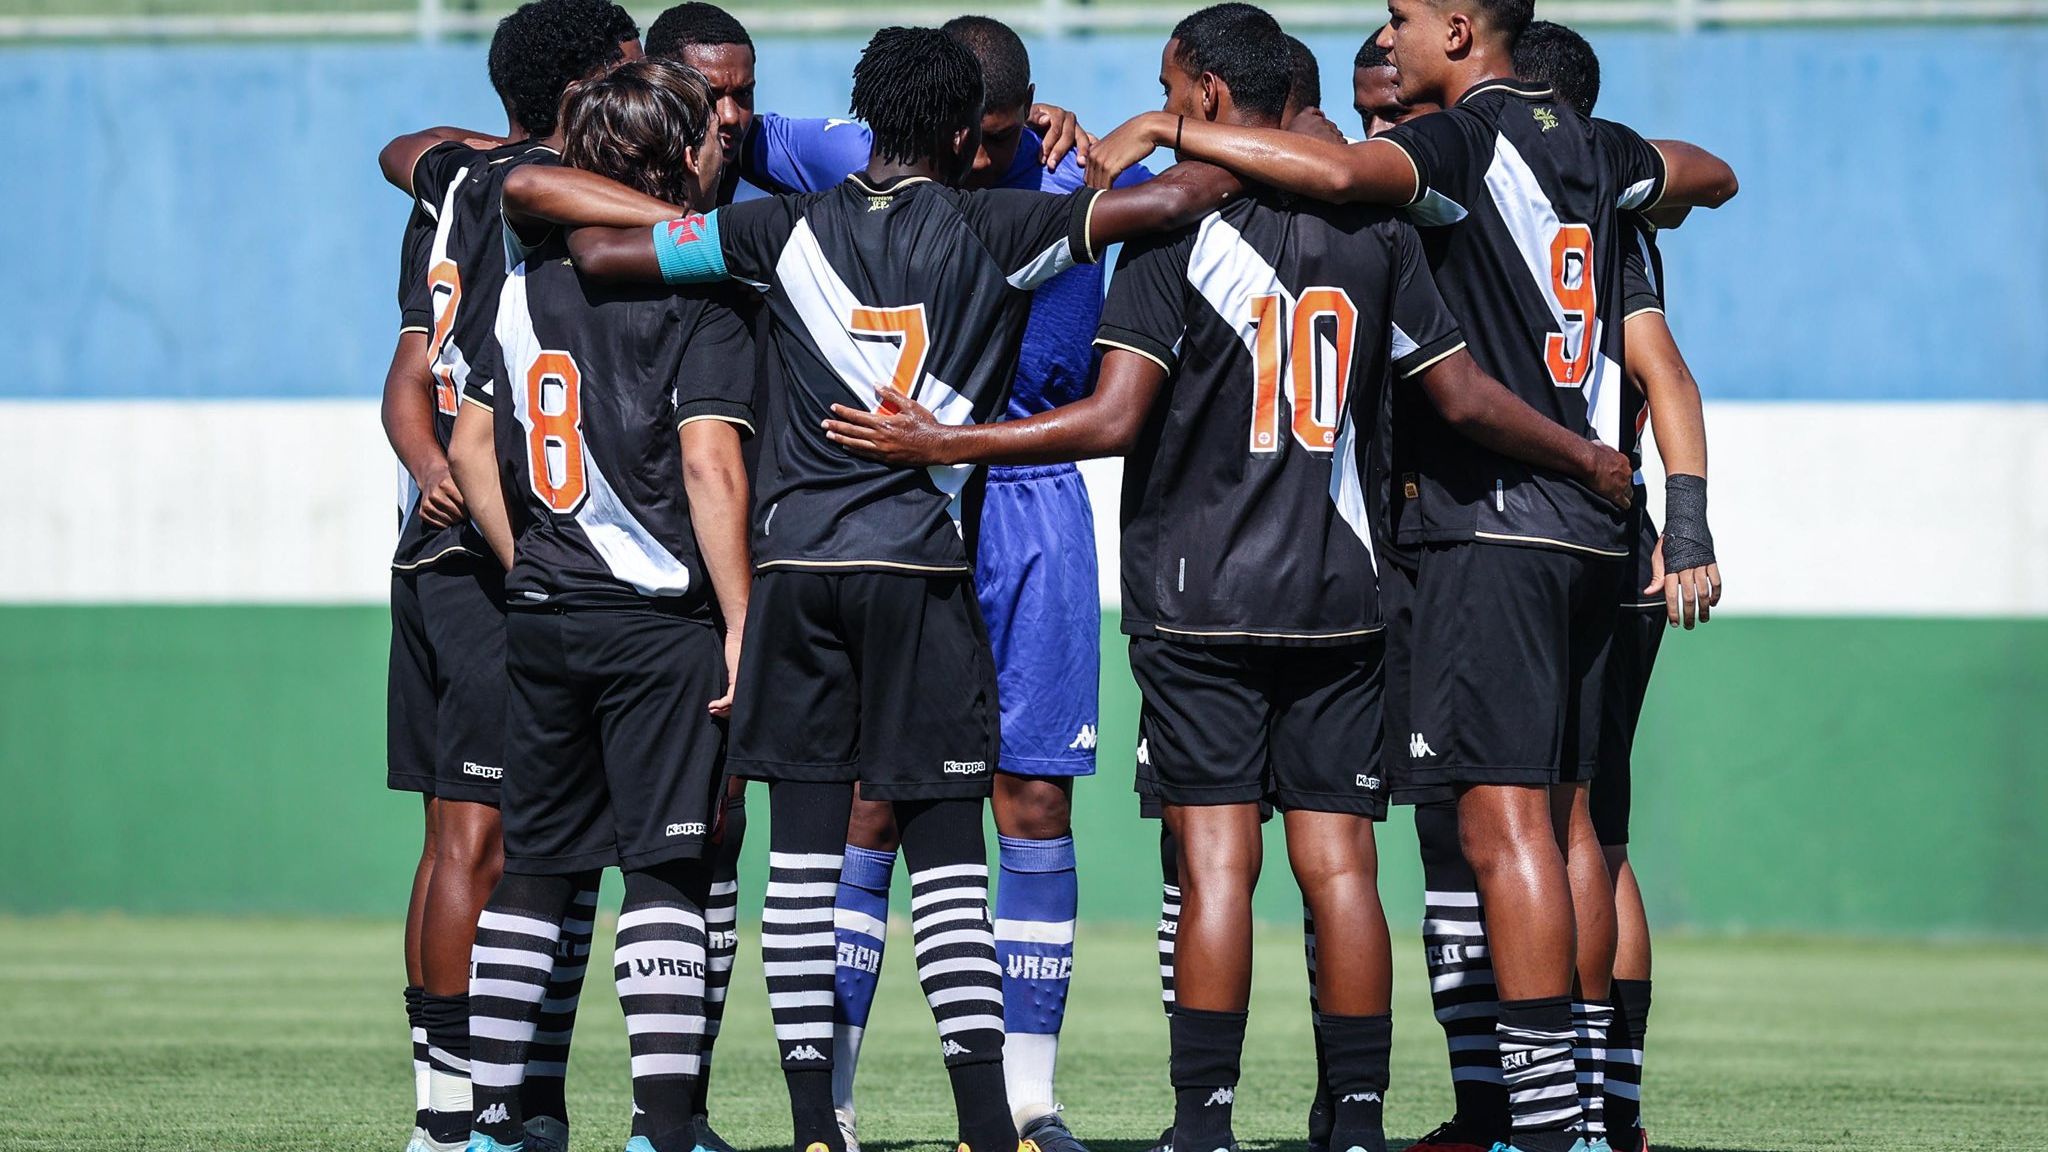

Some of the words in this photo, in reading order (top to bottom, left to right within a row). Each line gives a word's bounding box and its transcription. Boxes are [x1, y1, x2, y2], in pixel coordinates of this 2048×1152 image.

[848, 303, 931, 416] 7
[1247, 286, 1359, 452] 10
[1544, 223, 1597, 389] 9
[525, 350, 587, 513] 8
[665, 822, 707, 836] Kapp
[944, 760, 985, 775] Kappa
